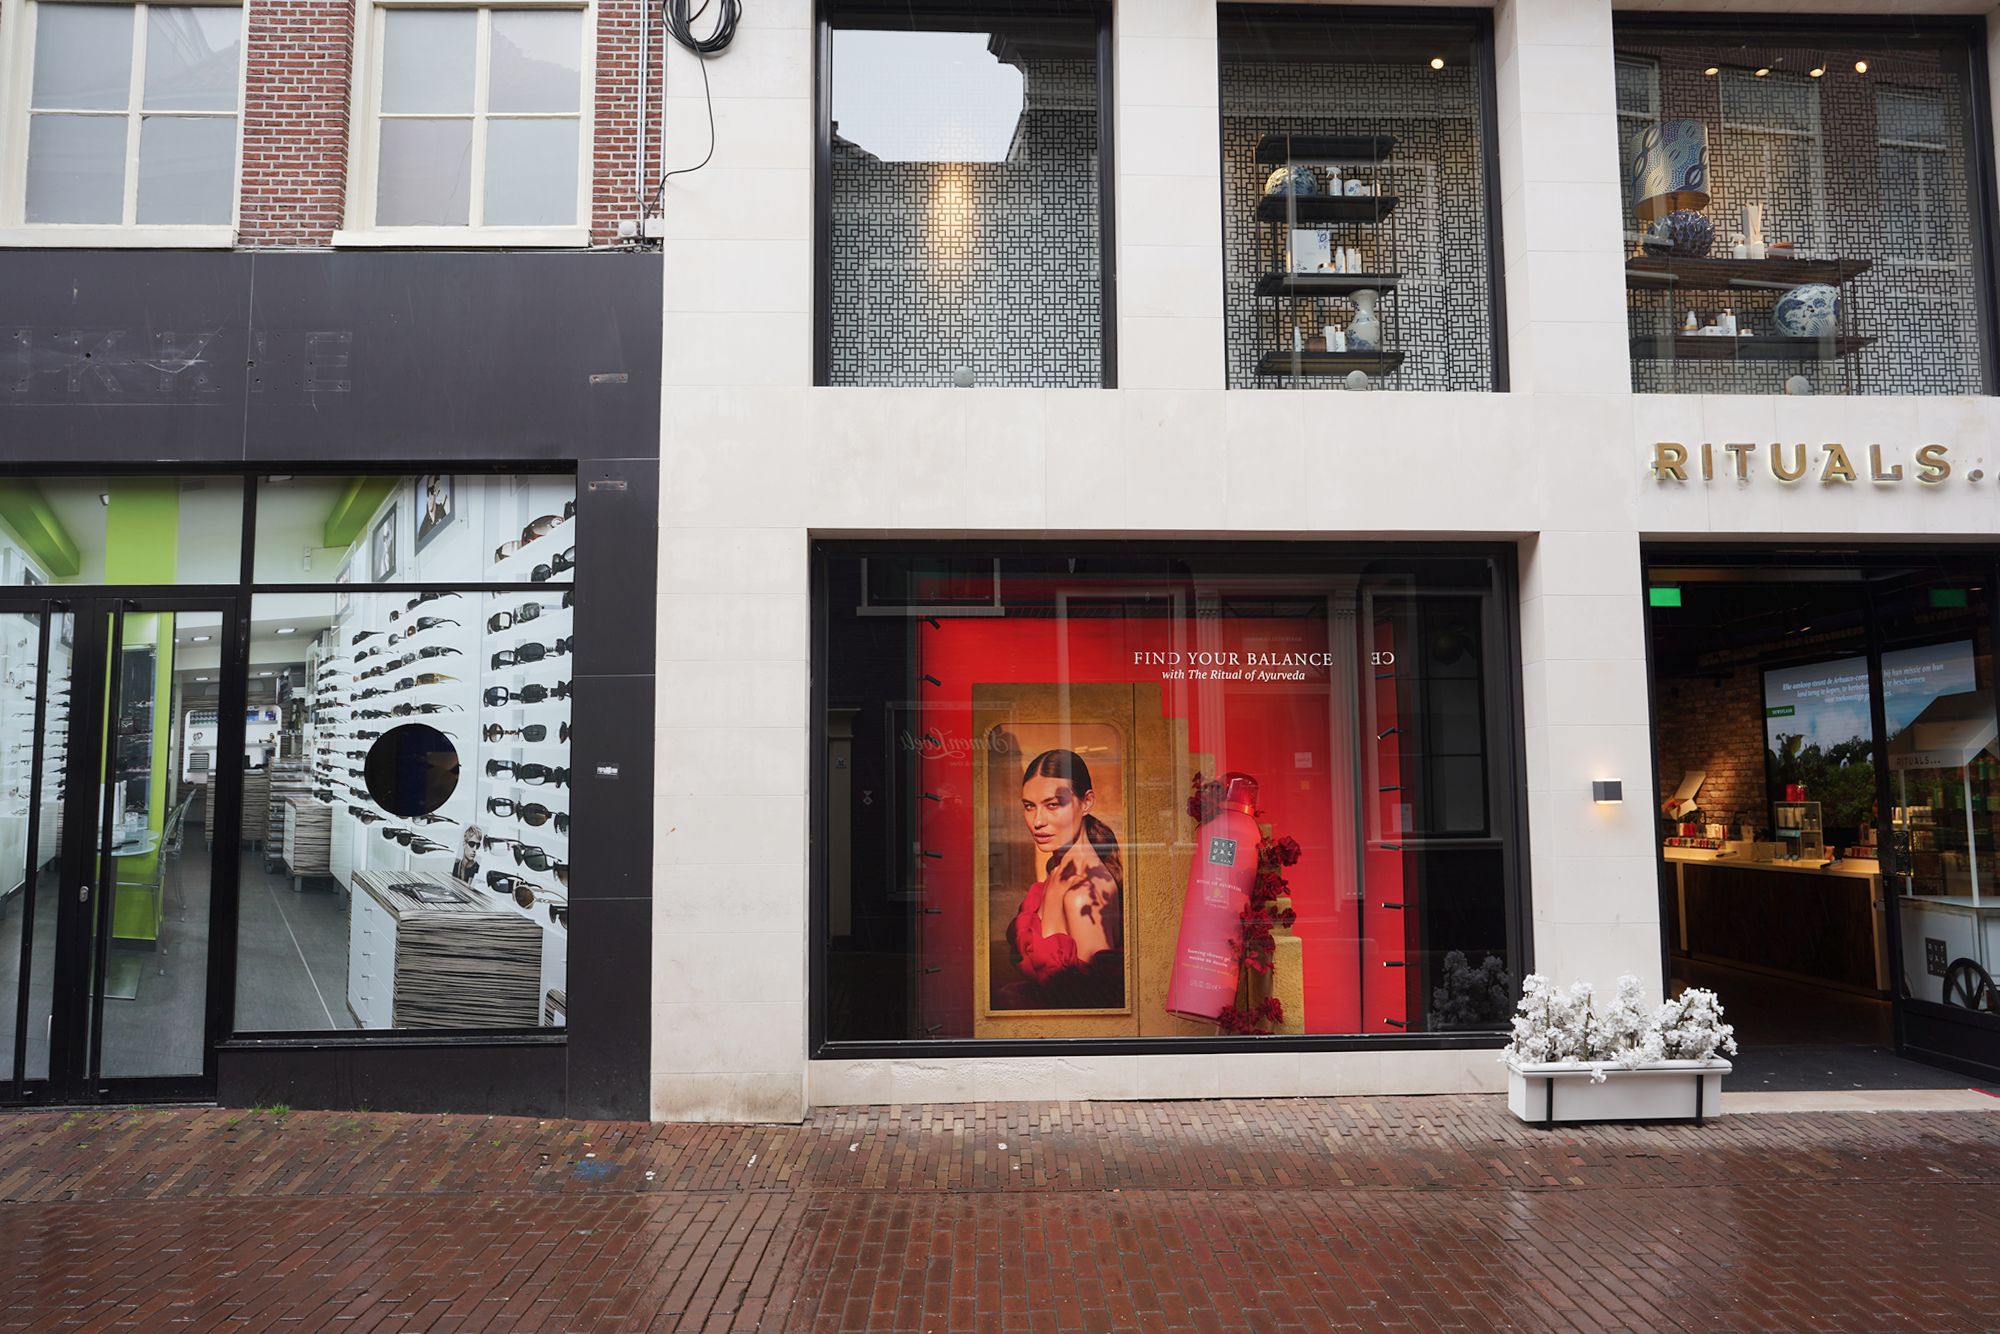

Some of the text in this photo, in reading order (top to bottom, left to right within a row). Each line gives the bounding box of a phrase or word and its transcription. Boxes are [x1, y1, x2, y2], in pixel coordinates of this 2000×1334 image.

[1651, 442, 2000, 483] RITUALS.
[1134, 652, 1333, 666] FIND YOUR BALANCE
[1162, 669, 1305, 682] with The Ritual of Ayurveda
